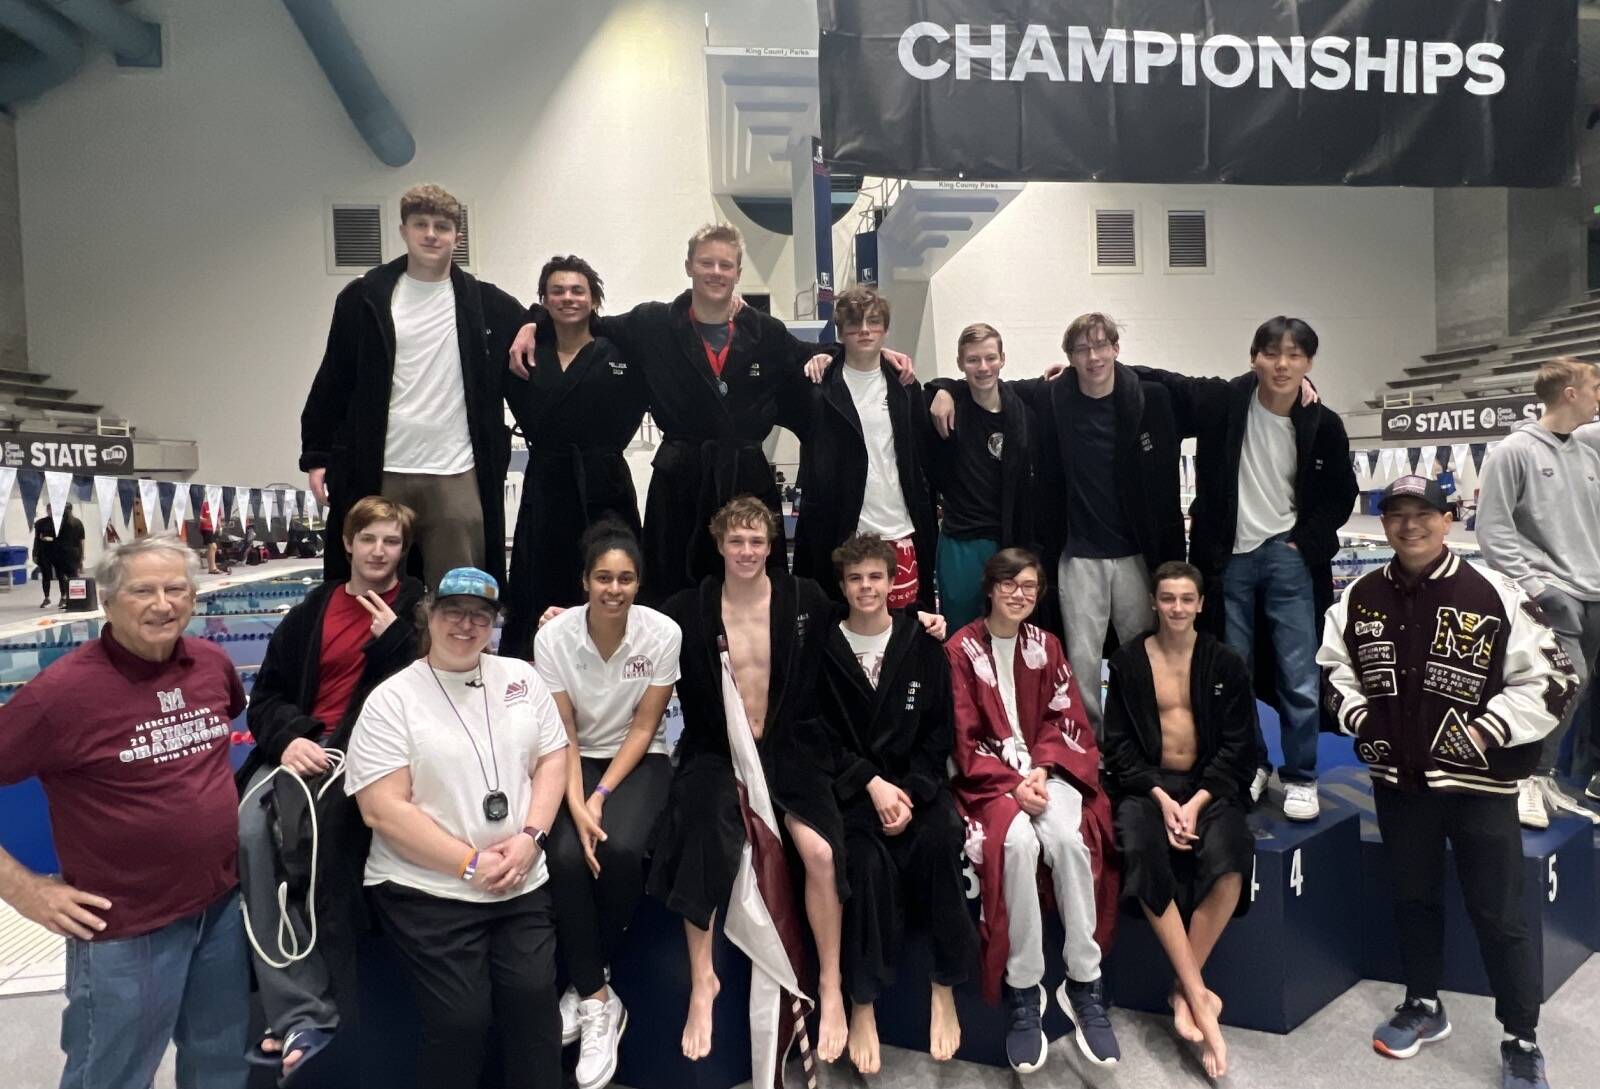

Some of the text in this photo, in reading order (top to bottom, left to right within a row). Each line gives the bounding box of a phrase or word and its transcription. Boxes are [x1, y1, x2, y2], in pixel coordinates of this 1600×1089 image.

[745, 47, 809, 57] King County Parks
[898, 22, 1507, 96] CHAMPIONSHIPS
[939, 181, 954, 190] King
[956, 181, 978, 189] County
[1415, 409, 1475, 433] STATE
[30, 441, 97, 467] STATE
[1431, 674, 1448, 684] 200
[1451, 672, 1481, 687] RECORD
[130, 735, 147, 747] 20
[150, 717, 207, 743] STATE
[135, 707, 211, 733] MERCER ISLAND
[119, 723, 229, 763] CHAMPIONS
[153, 752, 181, 764] SWIM
[191, 742, 213, 755] DIVE
[1289, 848, 1304, 897] 4
[1548, 854, 1558, 903] 5
